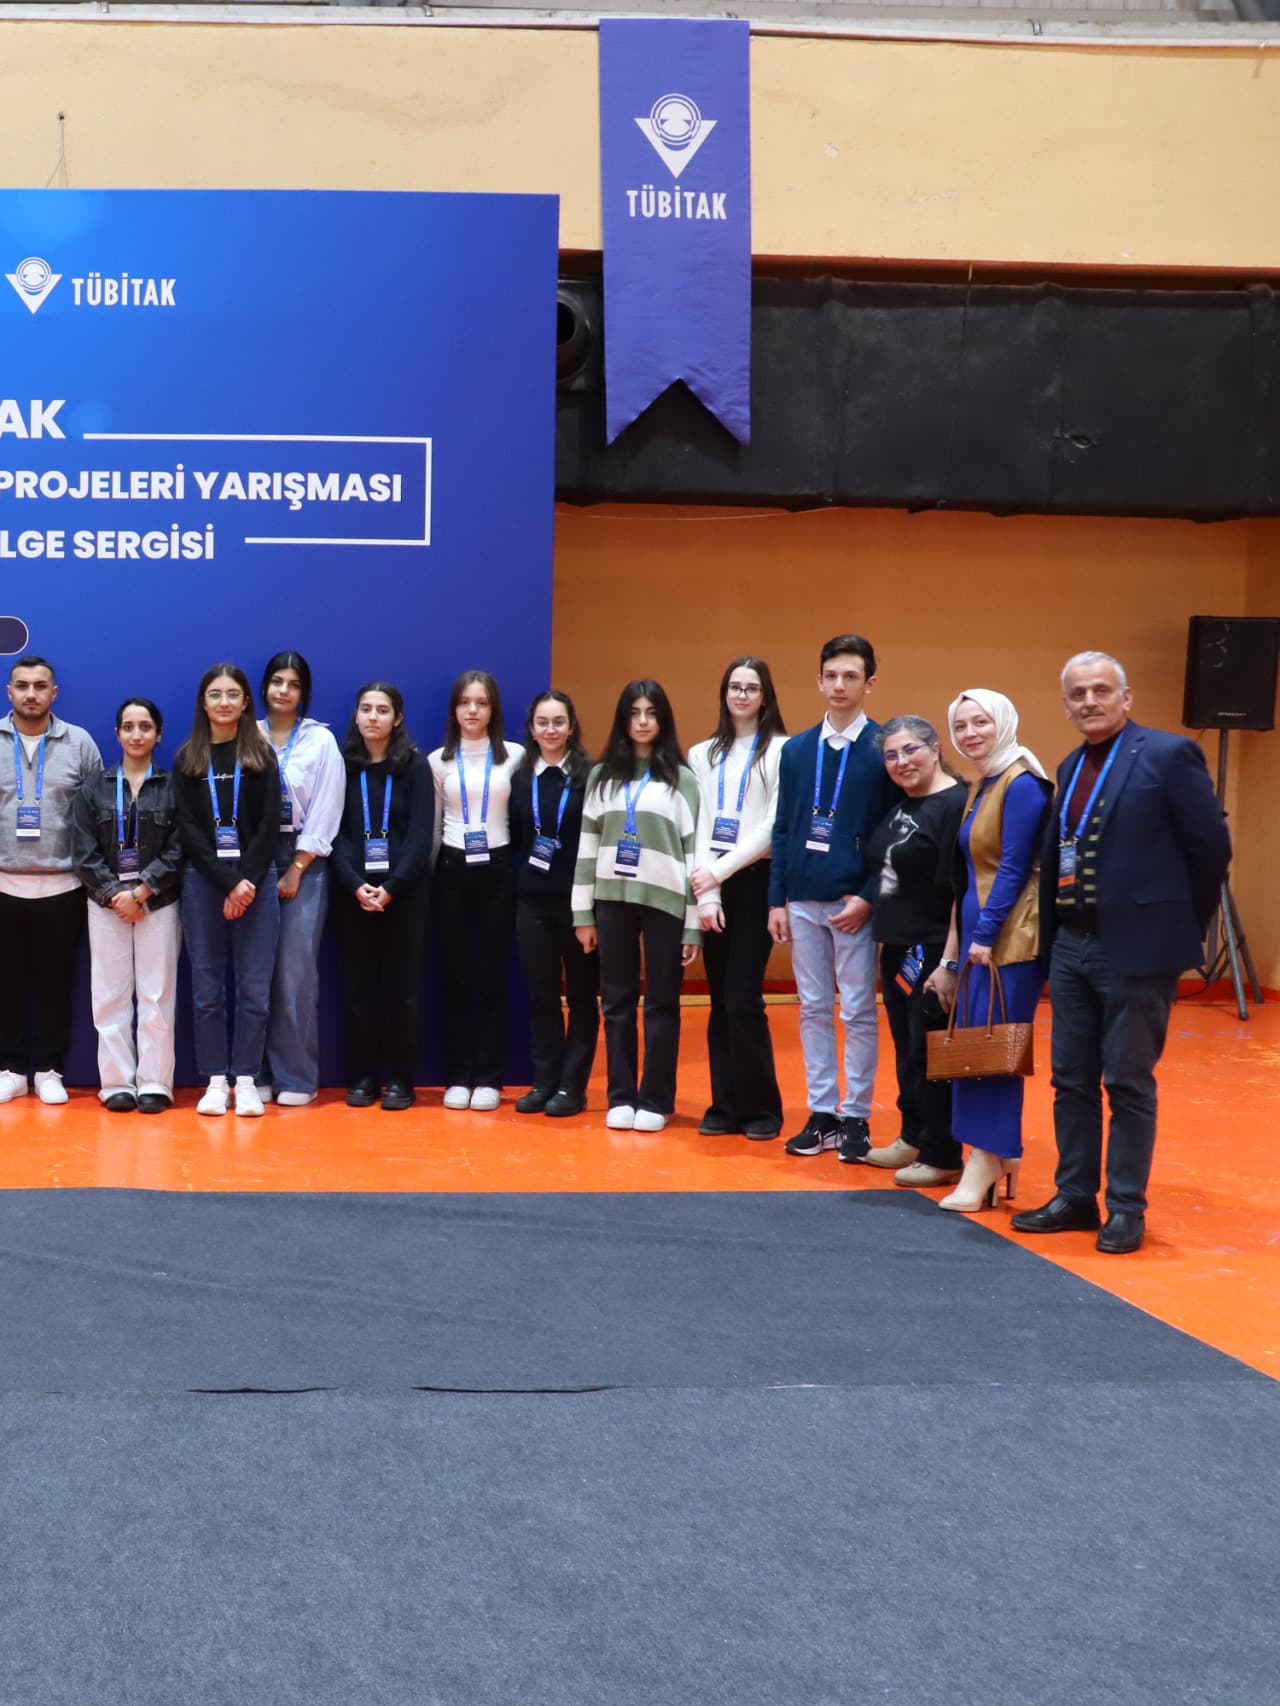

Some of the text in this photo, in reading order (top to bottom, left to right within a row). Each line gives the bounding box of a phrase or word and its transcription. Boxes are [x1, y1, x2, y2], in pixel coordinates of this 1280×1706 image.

[626, 184, 728, 220] TÜBİTAK
[72, 272, 177, 306] TÜBİTAK
[193, 471, 403, 510] YARIŞMASI
[73, 523, 216, 560] SERGİSİ
